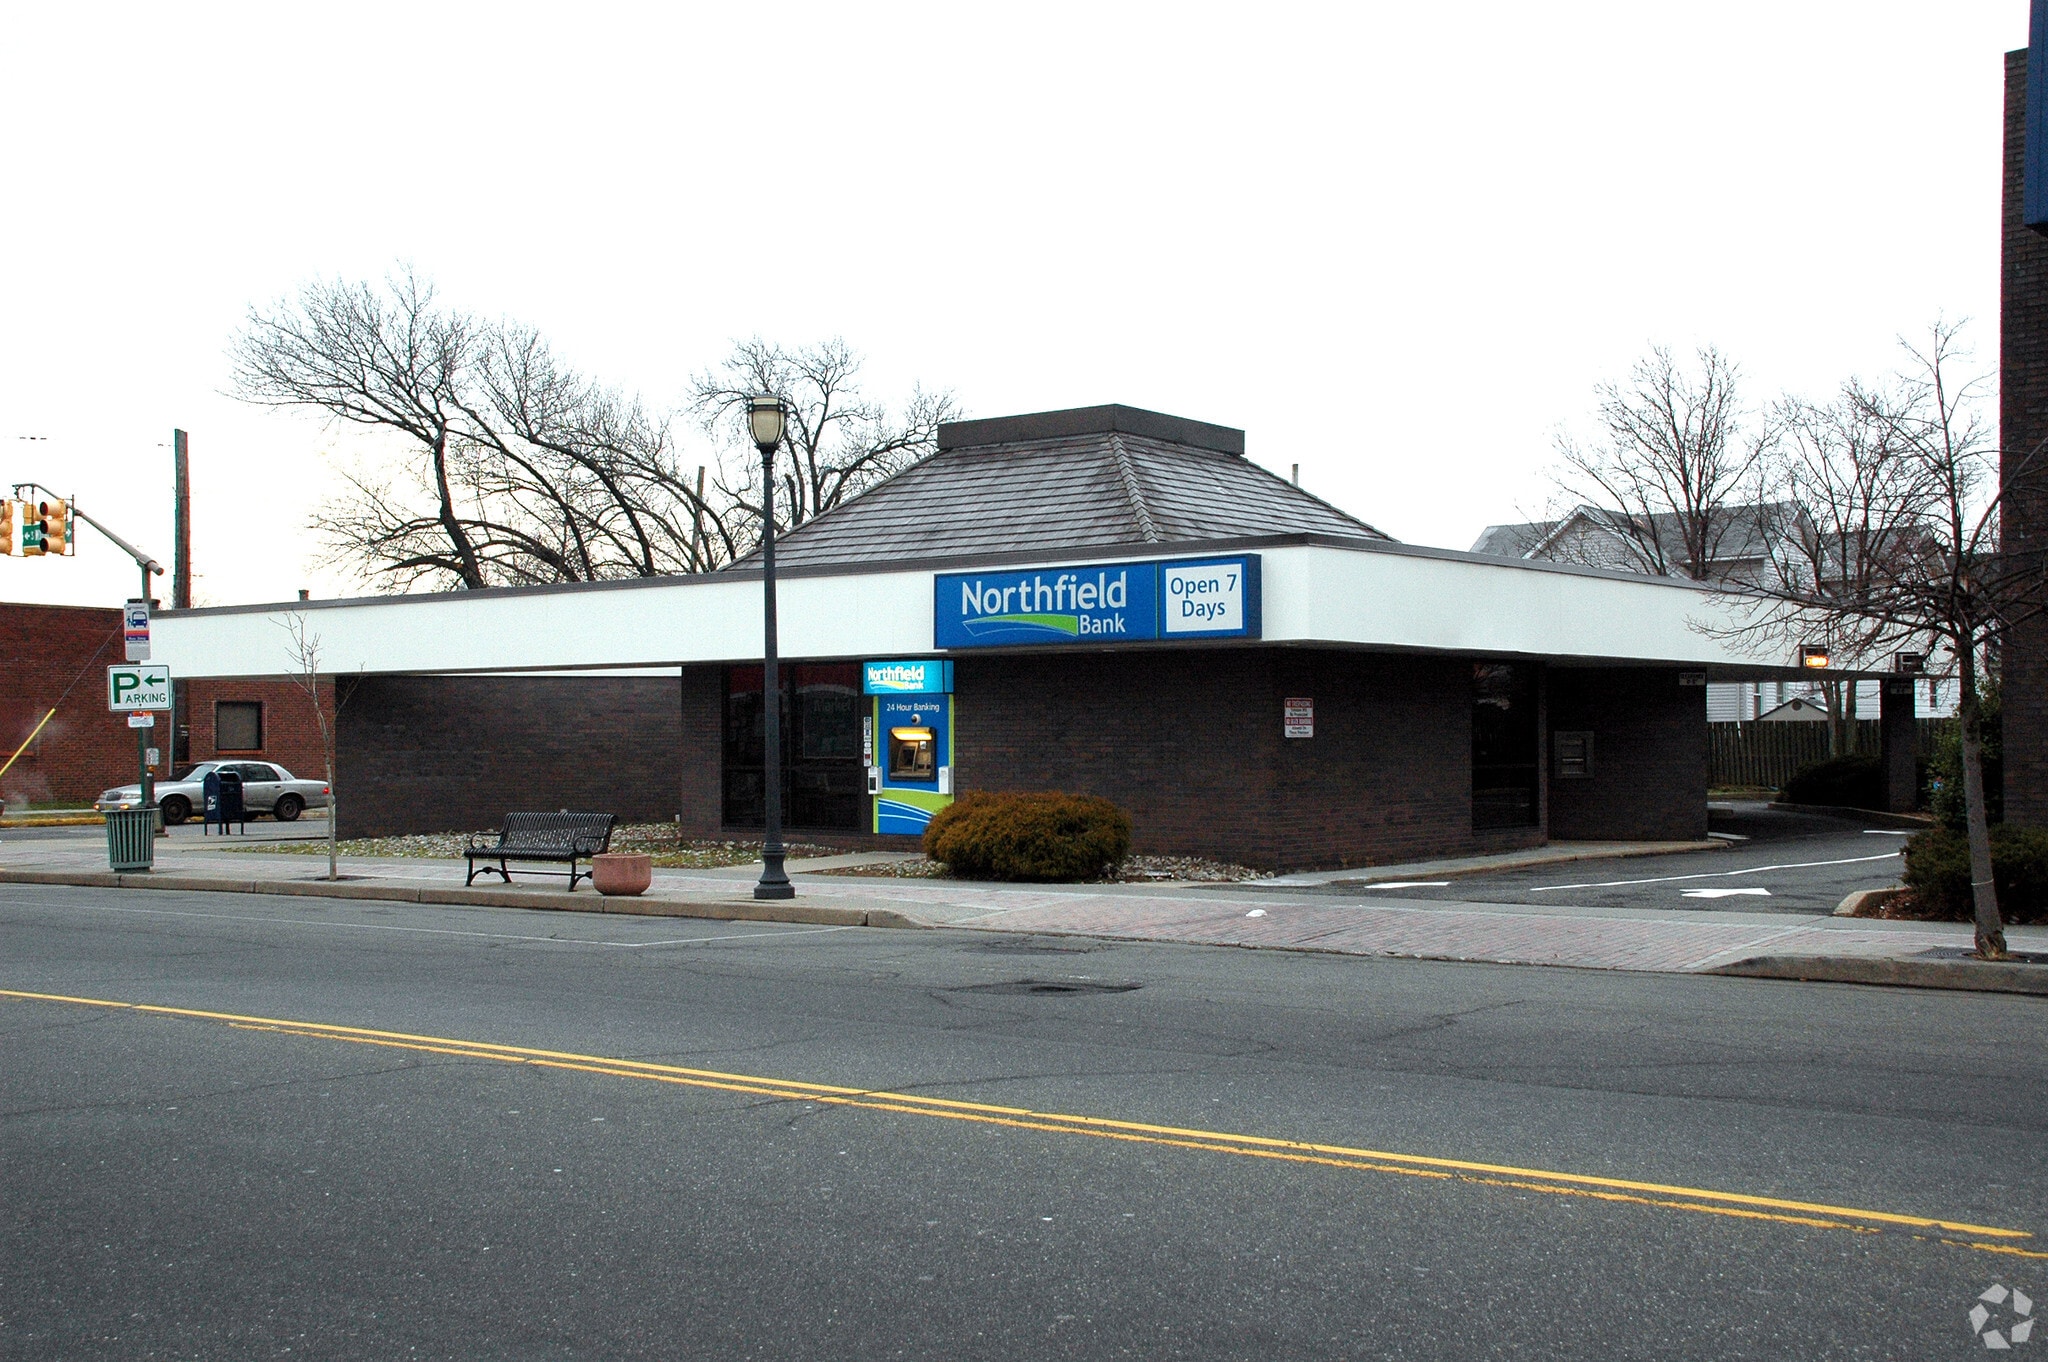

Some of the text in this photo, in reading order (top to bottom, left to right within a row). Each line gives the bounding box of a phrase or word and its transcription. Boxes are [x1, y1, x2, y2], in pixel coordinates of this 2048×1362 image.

[962, 570, 1127, 615] Northfield
[1170, 573, 1237, 599] Open 7
[1182, 600, 1226, 621] Days
[1080, 612, 1126, 634] Bank
[868, 666, 924, 681] Northfield
[905, 682, 924, 690] Bank
[913, 702, 940, 713] Banking
